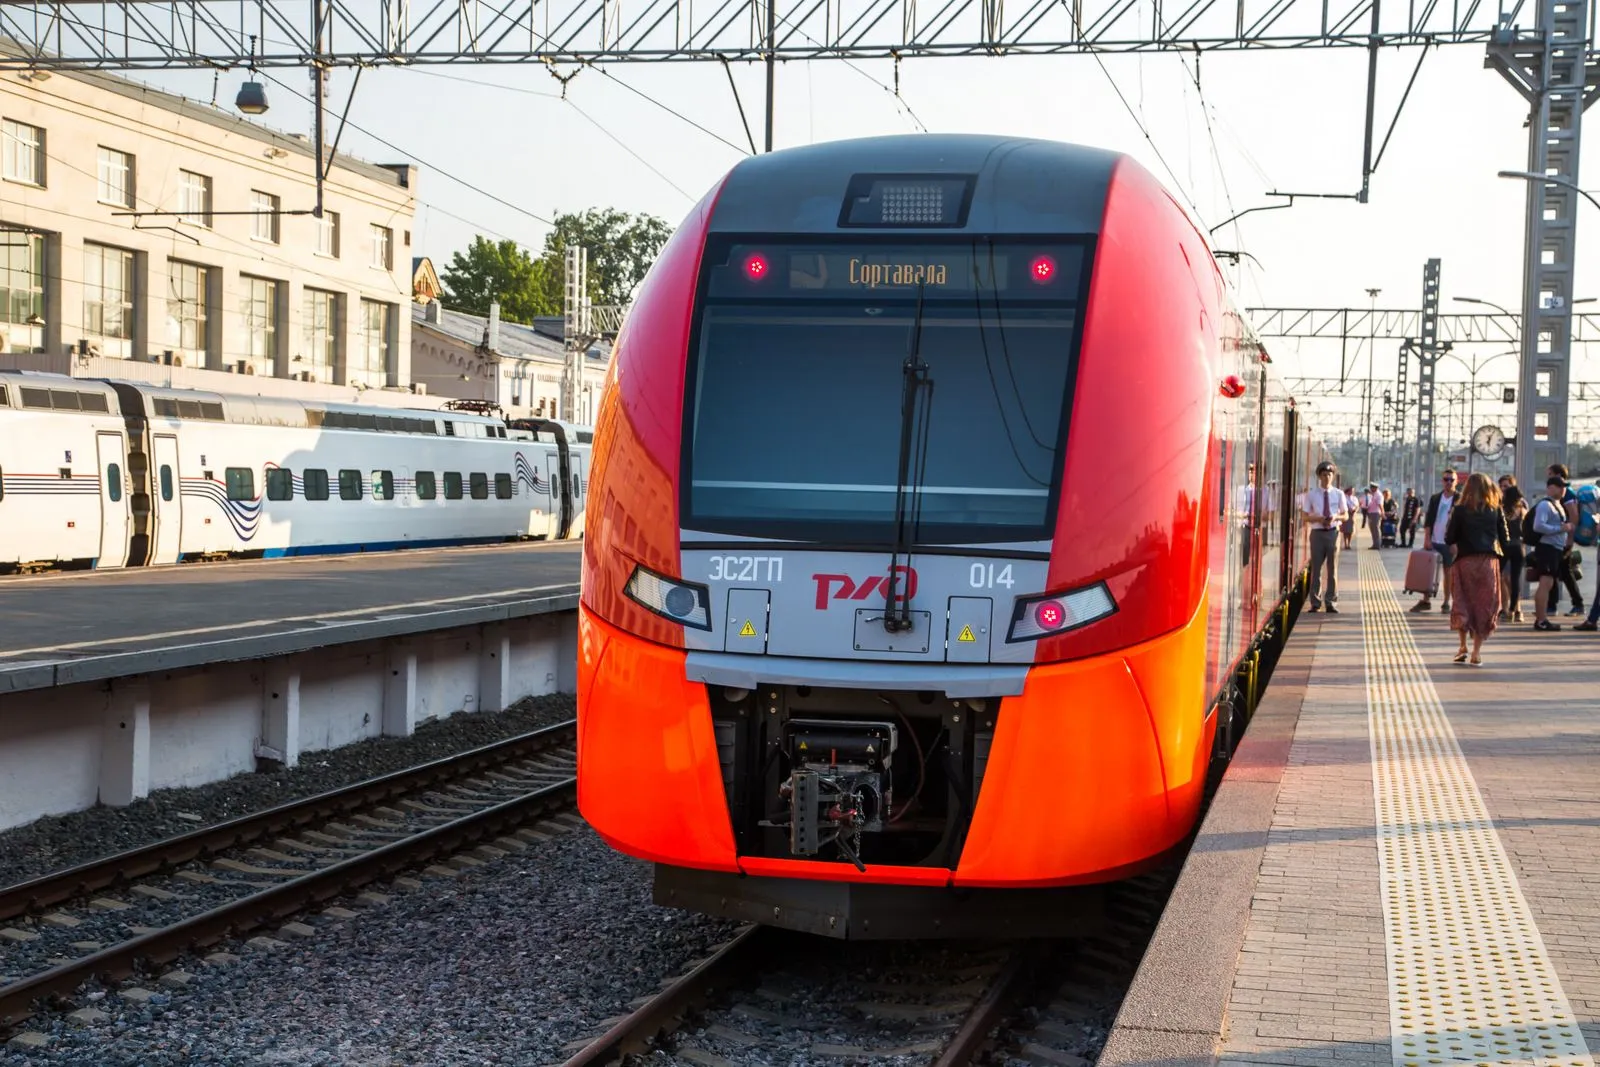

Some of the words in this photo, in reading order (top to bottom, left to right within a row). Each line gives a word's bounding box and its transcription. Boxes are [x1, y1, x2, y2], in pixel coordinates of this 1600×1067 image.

[849, 258, 946, 288] Сортавала
[708, 556, 783, 581] ЭС2ГП
[969, 562, 1015, 589] 014
